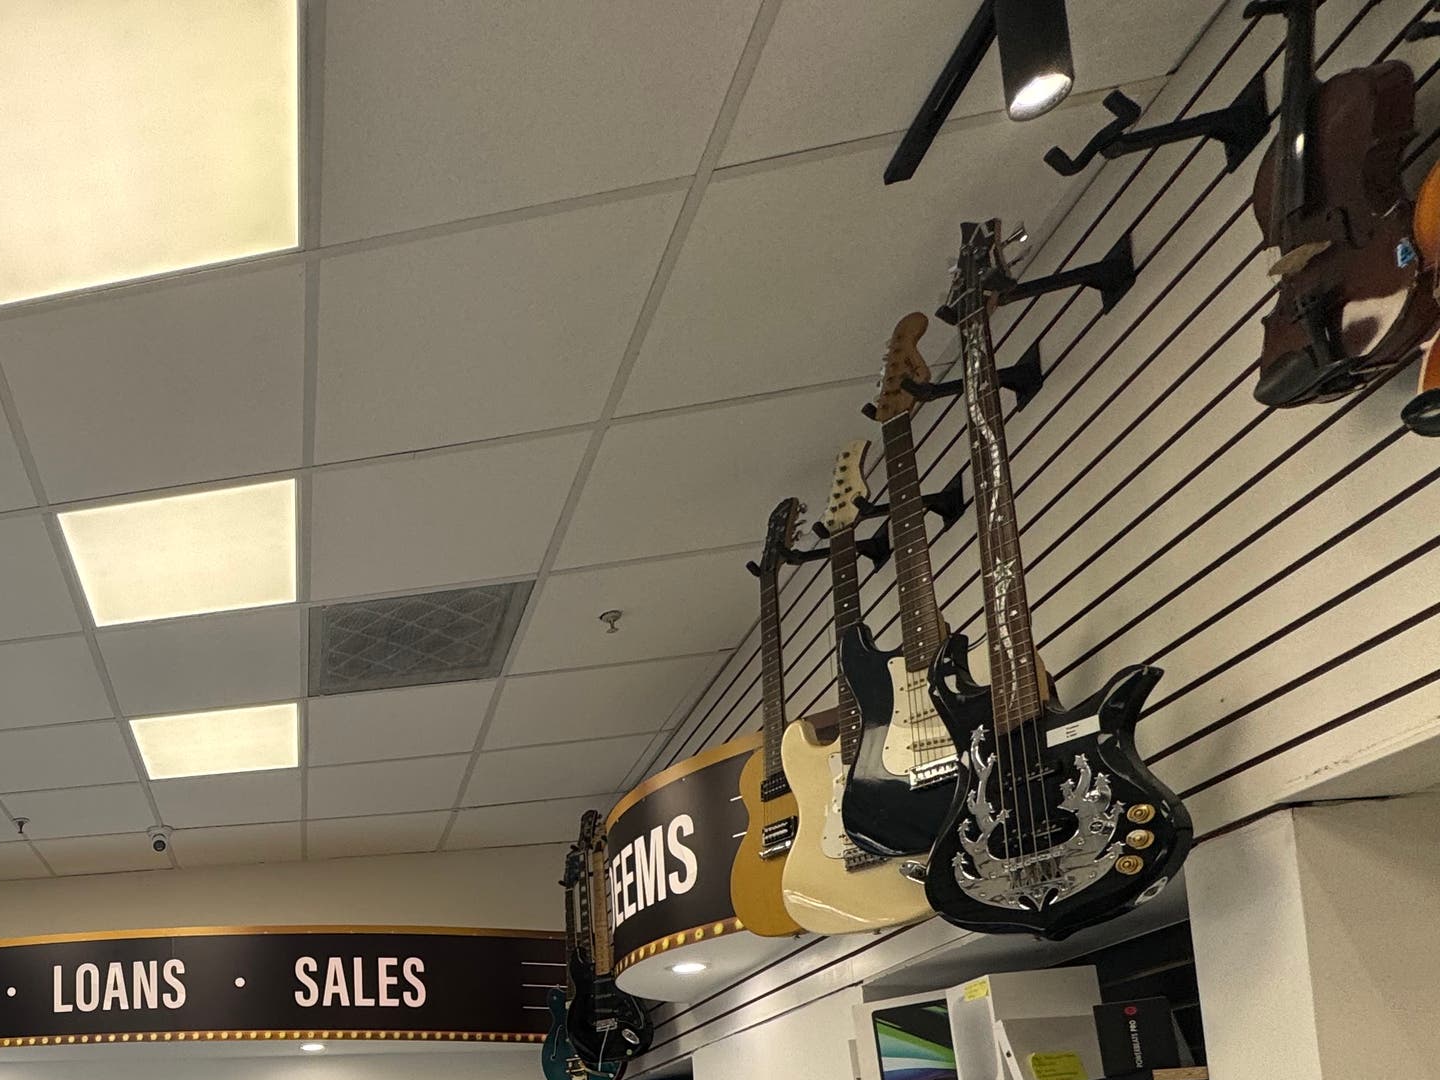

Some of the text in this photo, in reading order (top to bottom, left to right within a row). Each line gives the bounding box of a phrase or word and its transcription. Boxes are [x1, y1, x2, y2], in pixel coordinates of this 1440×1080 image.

[610, 814, 698, 933] EEMS
[53, 958, 186, 1013] LOANS
[294, 956, 426, 1008] SALES
